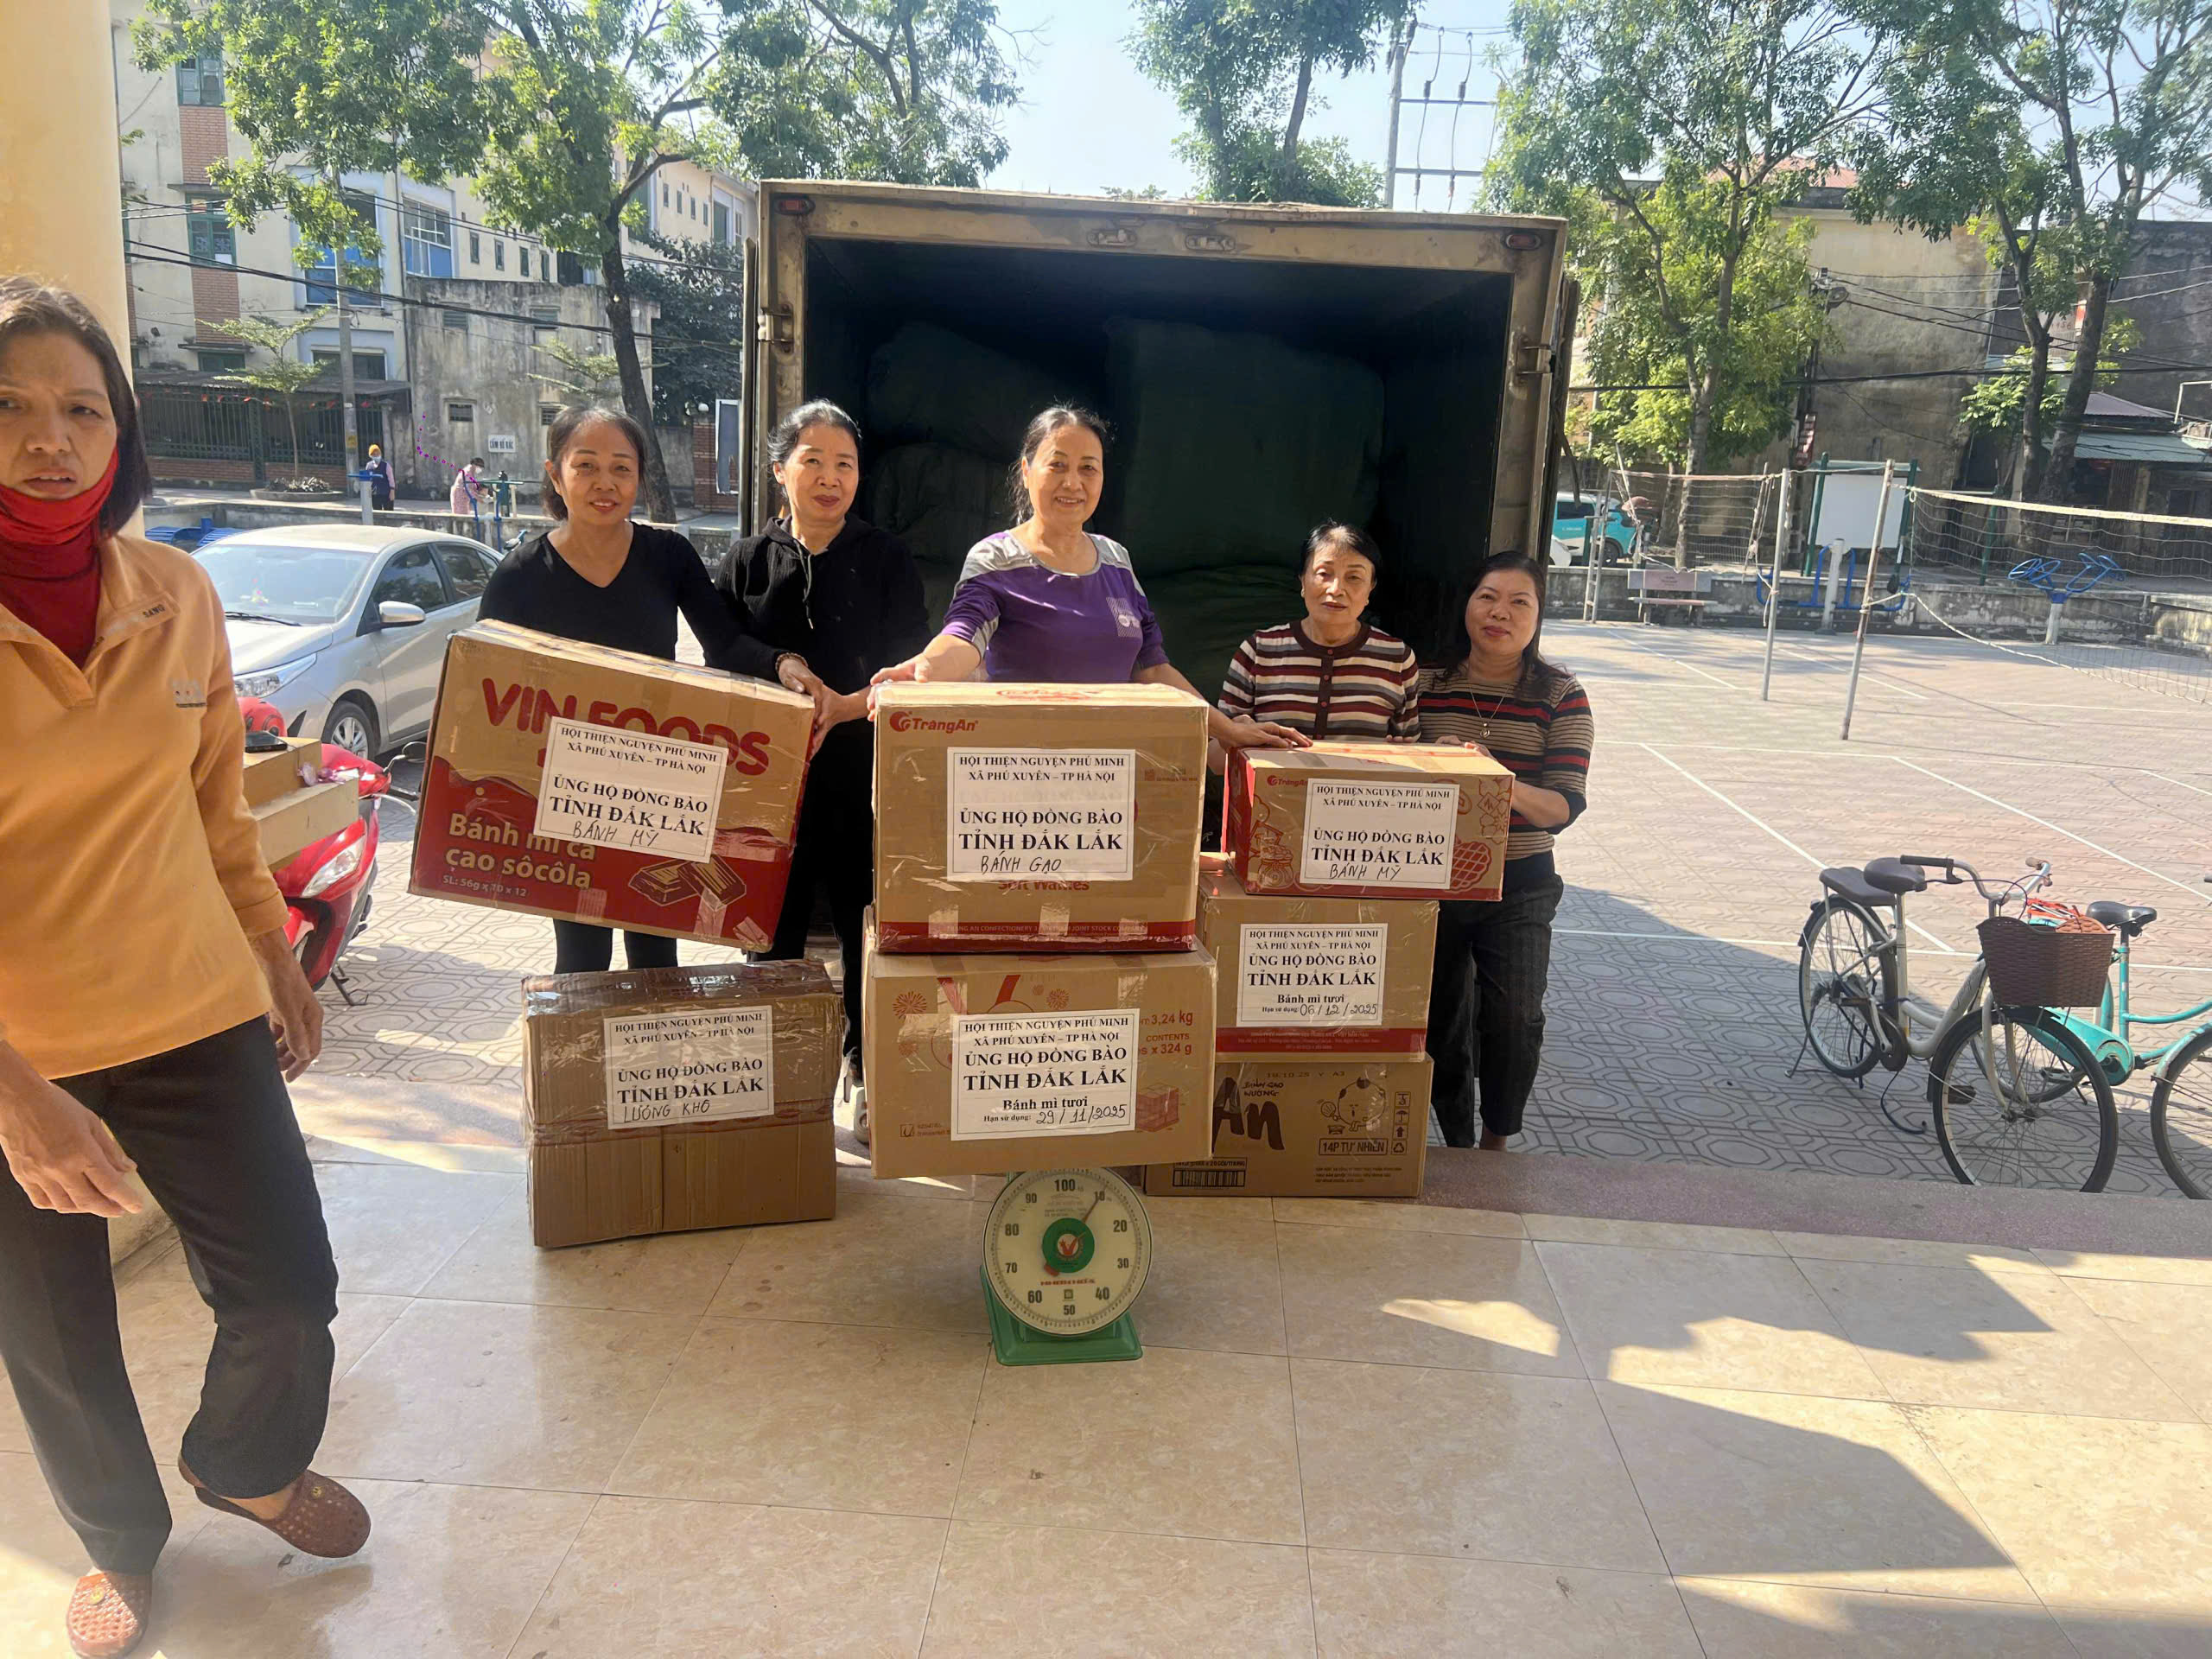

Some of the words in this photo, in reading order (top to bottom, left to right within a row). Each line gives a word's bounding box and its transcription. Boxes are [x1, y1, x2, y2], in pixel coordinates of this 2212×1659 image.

[482, 677, 577, 734] VIN
[562, 728, 581, 738] HỘI
[585, 732, 616, 745] THIỆN
[620, 739, 662, 752] NGUYỆN
[665, 747, 686, 757] PHÚ
[689, 751, 716, 762] MINH
[960, 756, 980, 767] HỘI
[983, 756, 1017, 767] THIỆN
[1020, 757, 1066, 767] NGUYỆN
[1070, 756, 1092, 766] PHÚ
[1095, 758, 1124, 766] MINH
[969, 770, 984, 780] XÃ
[988, 771, 1009, 780] PHÚ
[1013, 771, 1050, 781] XUYÊN
[1077, 771, 1091, 781] HÀ
[1096, 772, 1115, 783] NỘI
[594, 784, 618, 800] HỘ
[622, 788, 670, 807] ĐỒNG
[674, 796, 708, 813] BÀO
[1317, 786, 1333, 795] HỘI
[1336, 787, 1363, 797] THIỆN
[1365, 789, 1403, 798] NGUYỆN
[1410, 800, 1422, 809] HÀ
[1426, 802, 1441, 810] NỘI
[550, 795, 603, 819] TỈNH
[608, 805, 655, 828] ĐẮK
[660, 815, 705, 836] LẮK
[960, 808, 996, 824] ỦNG
[1002, 810, 1027, 827] HỘ
[1033, 809, 1082, 824] ĐỒNG
[1087, 809, 1122, 824] BÀO
[448, 812, 518, 847] Bánh
[573, 820, 617, 842] BÁNH
[1347, 831, 1368, 844] HỘ
[1371, 830, 1412, 843] ĐỒNG
[1416, 831, 1445, 844] BÀO
[959, 829, 1014, 849] TỈNH
[1021, 830, 1071, 849] ĐẮK
[1076, 830, 1123, 849] LẮK
[1312, 844, 1356, 861] TỈNH
[1362, 846, 1401, 863] ĐẮK
[1406, 848, 1444, 865] LẮK
[446, 849, 495, 871] cao
[501, 855, 590, 889] sôcôla
[981, 851, 1020, 874] BÁNH
[1029, 857, 1062, 874] GẠO
[1330, 863, 1367, 879] BÁNH
[442, 874, 459, 886] SL:
[461, 879, 480, 890] 56g
[516, 887, 527, 897] 12
[1249, 931, 1266, 939] HỘI
[1268, 931, 1294, 939] THIỆN
[1298, 931, 1334, 939] NGUYỆN
[1282, 954, 1302, 968] HỘ
[1306, 953, 1344, 965] ĐỒNG
[1349, 953, 1376, 964] BÀO
[1248, 969, 1291, 986] TỈNH
[1297, 970, 1334, 985] ĐẮK
[1339, 969, 1376, 985] LẮK
[1277, 995, 1304, 1003] Bánh
[1307, 995, 1320, 1003] mì
[965, 1024, 986, 1033] HỘI
[988, 1023, 1023, 1033] THIỆN
[1027, 1020, 1071, 1031] NGUYỆN
[1075, 1017, 1096, 1027] PHÚ
[1099, 1018, 1128, 1027] MINH
[1152, 1014, 1175, 1026] 3,24
[1179, 1010, 1192, 1026] kg
[975, 1038, 988, 1046] XÃ
[993, 1036, 1014, 1045] PHÚ
[1018, 1033, 1055, 1044] XUYÊN
[1082, 1032, 1096, 1041] HÀ
[1099, 1033, 1119, 1042] NỘI
[1147, 1033, 1189, 1042] CONTENTS
[1007, 1052, 1033, 1066] HỘ
[1038, 1047, 1086, 1064] ĐỒNG
[1092, 1046, 1127, 1061] BÀO
[1160, 1043, 1180, 1053] 324
[1185, 1045, 1192, 1055] g
[657, 1066, 678, 1080] HỘ
[683, 1063, 727, 1077] ĐỒNG
[732, 1058, 762, 1071] BÀO
[963, 1071, 1019, 1090] TỈNH
[1026, 1068, 1075, 1089] ĐẮK
[1081, 1065, 1127, 1085] LẮK
[618, 1085, 667, 1103] TỈNH
[674, 1080, 717, 1099] ĐẮK
[723, 1076, 764, 1094] LẮK
[1003, 1099, 1037, 1111] Bánh
[1041, 1097, 1057, 1109] mì
[1062, 1096, 1087, 1108] tươi
[1323, 1141, 1339, 1152] 14P
[1054, 1179, 1076, 1192] 100
[1026, 1193, 1037, 1204] 90
[1005, 1224, 1019, 1236] 80
[1113, 1220, 1128, 1232] 20
[1006, 1262, 1017, 1273] 70
[1117, 1258, 1129, 1268] 30
[1027, 1290, 1042, 1303] 60
[1096, 1287, 1110, 1300] 40
[1064, 1305, 1076, 1315] 50
